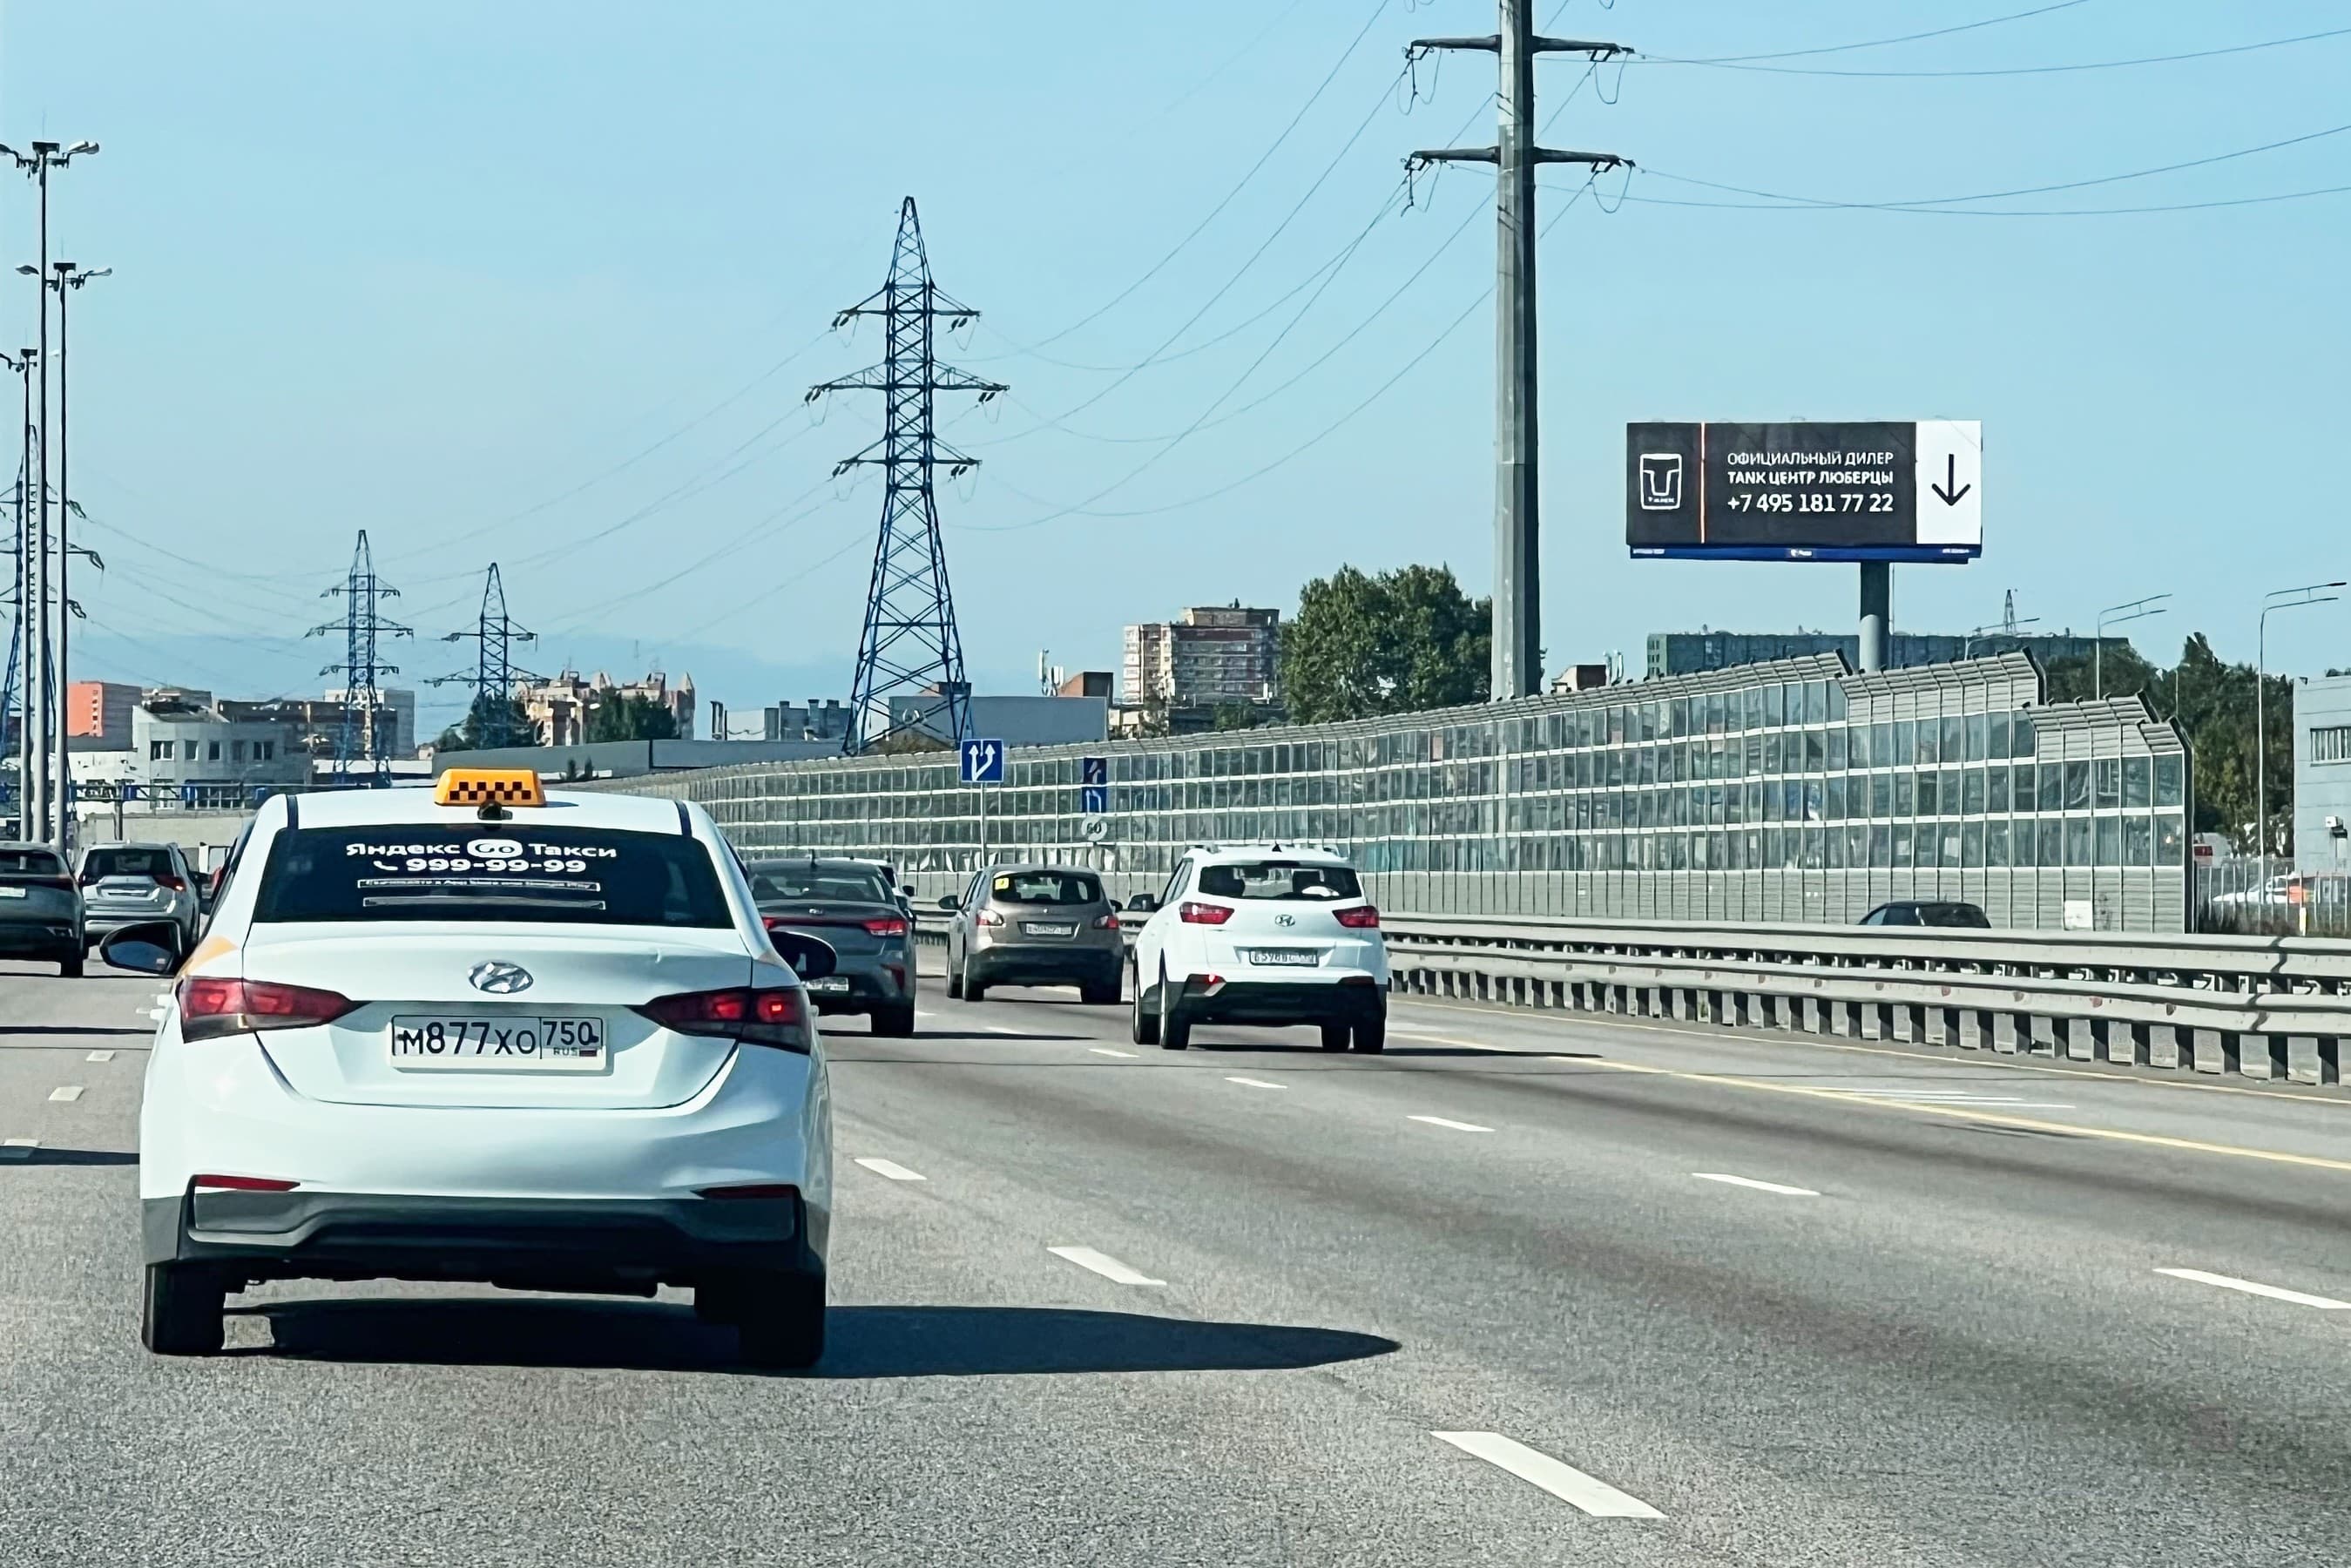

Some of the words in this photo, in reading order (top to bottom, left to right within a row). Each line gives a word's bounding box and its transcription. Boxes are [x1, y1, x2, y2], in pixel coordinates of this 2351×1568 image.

[1727, 451, 1842, 466] ОФИЦИАЛЬНЫЙ
[1844, 452, 1894, 466] ДИЛЕР
[1727, 471, 1767, 484] TANK
[1768, 471, 1816, 485] ЦЕНТР
[1819, 471, 1894, 485] ЛЮБЕРЦЫ
[1727, 494, 1752, 512] +7
[1756, 493, 1794, 512] 495
[1799, 493, 1836, 512] 181
[1840, 493, 1864, 512] 77
[1868, 493, 1894, 512] 22
[346, 843, 461, 856] Яндекс
[528, 843, 617, 857] Такси
[406, 858, 586, 872] 999-99-99
[543, 1021, 593, 1045] 750
